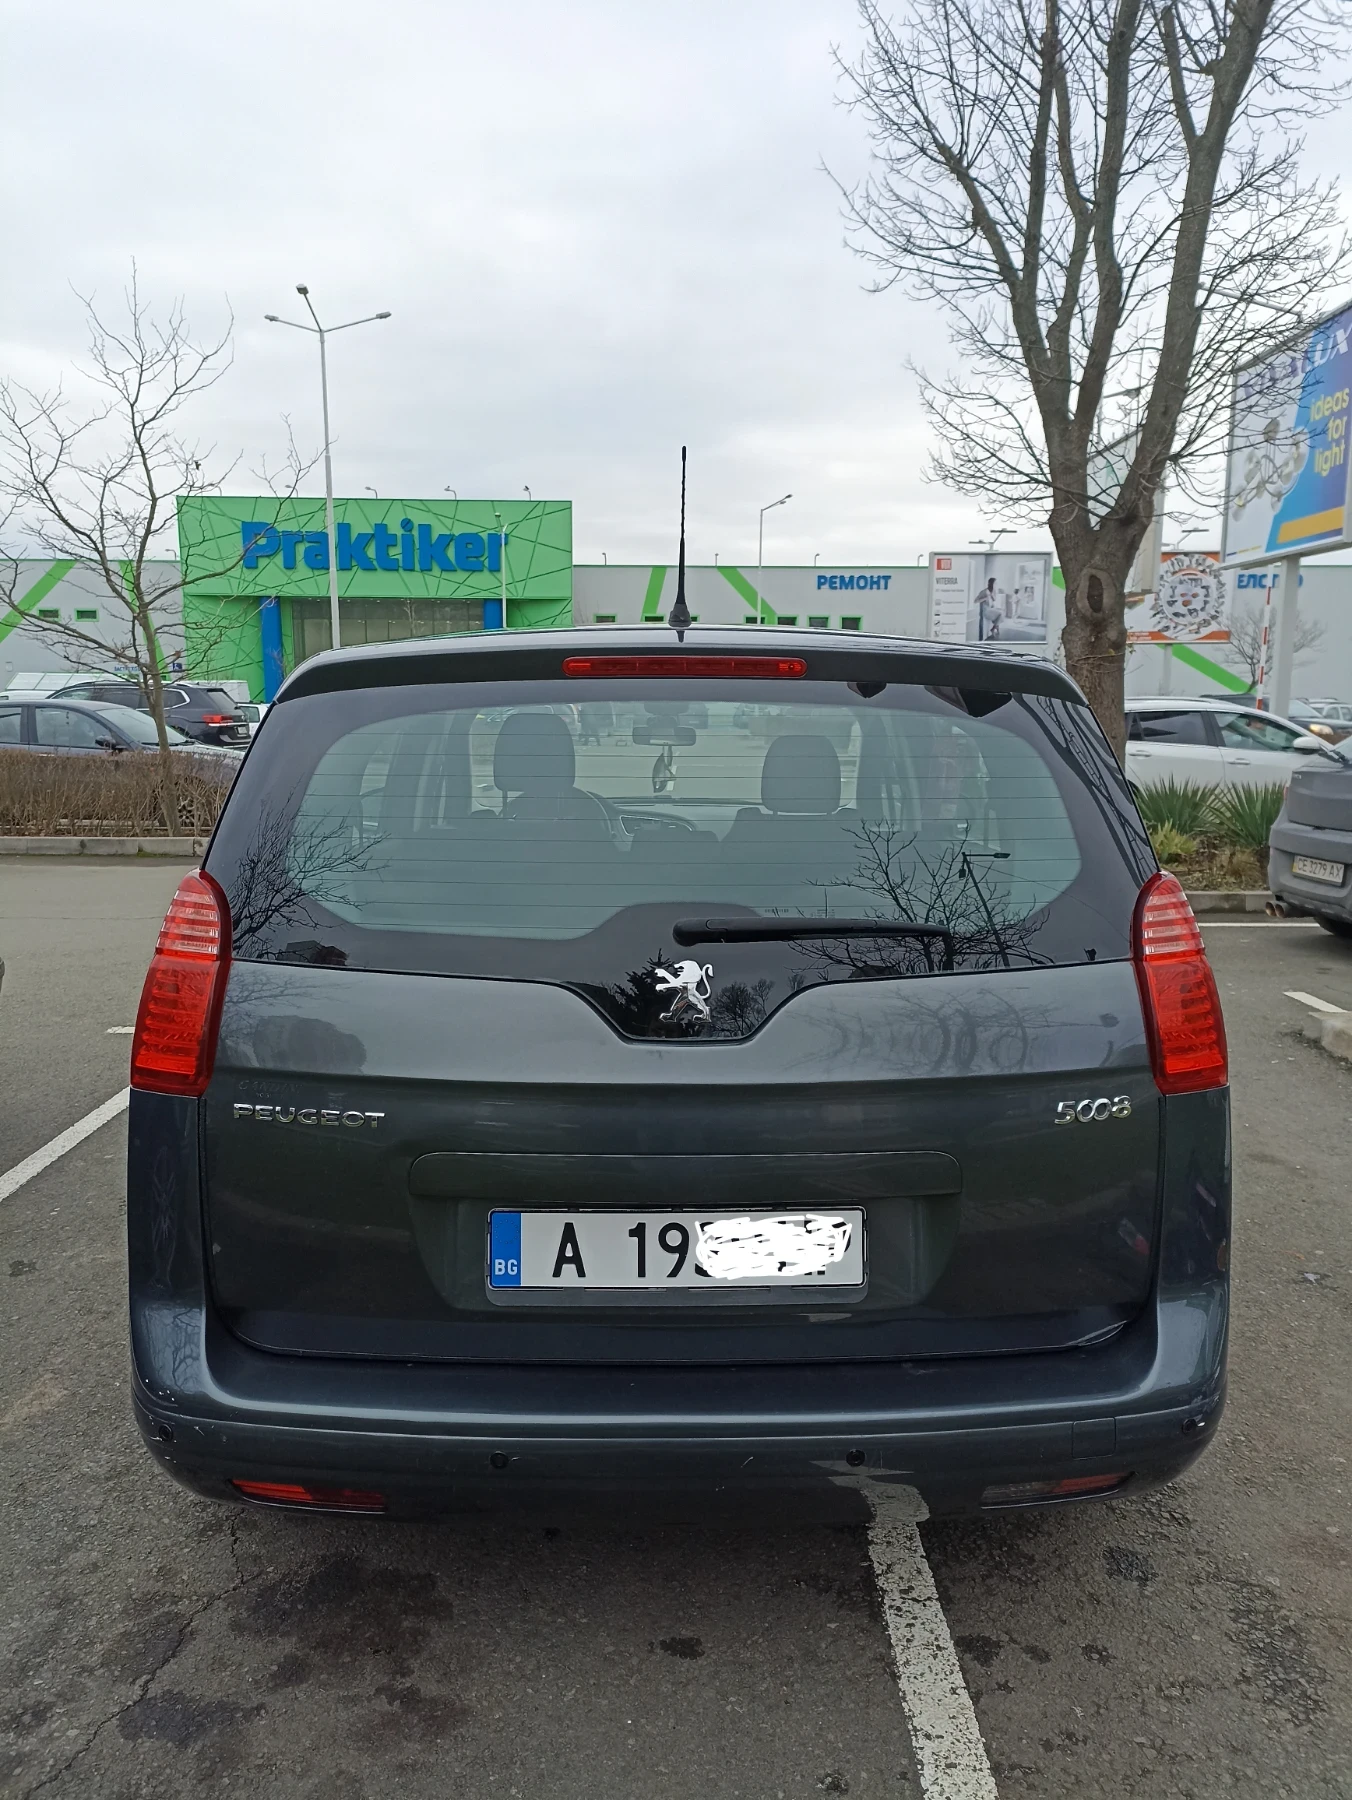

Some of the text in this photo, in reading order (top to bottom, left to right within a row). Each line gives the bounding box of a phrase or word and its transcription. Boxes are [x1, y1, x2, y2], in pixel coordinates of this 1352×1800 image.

[1310, 387, 1350, 422] ideas
[1327, 415, 1348, 442] for
[1313, 439, 1345, 477] light
[241, 518, 509, 572] Praktiker
[817, 575, 892, 590] РЕМОНТ
[1310, 861, 1328, 876] 3279
[1329, 864, 1343, 878] AX
[233, 1103, 385, 1128] PEUGEOT
[1054, 1095, 1132, 1124] 5008
[552, 1222, 586, 1278] A
[494, 1259, 518, 1276] BG
